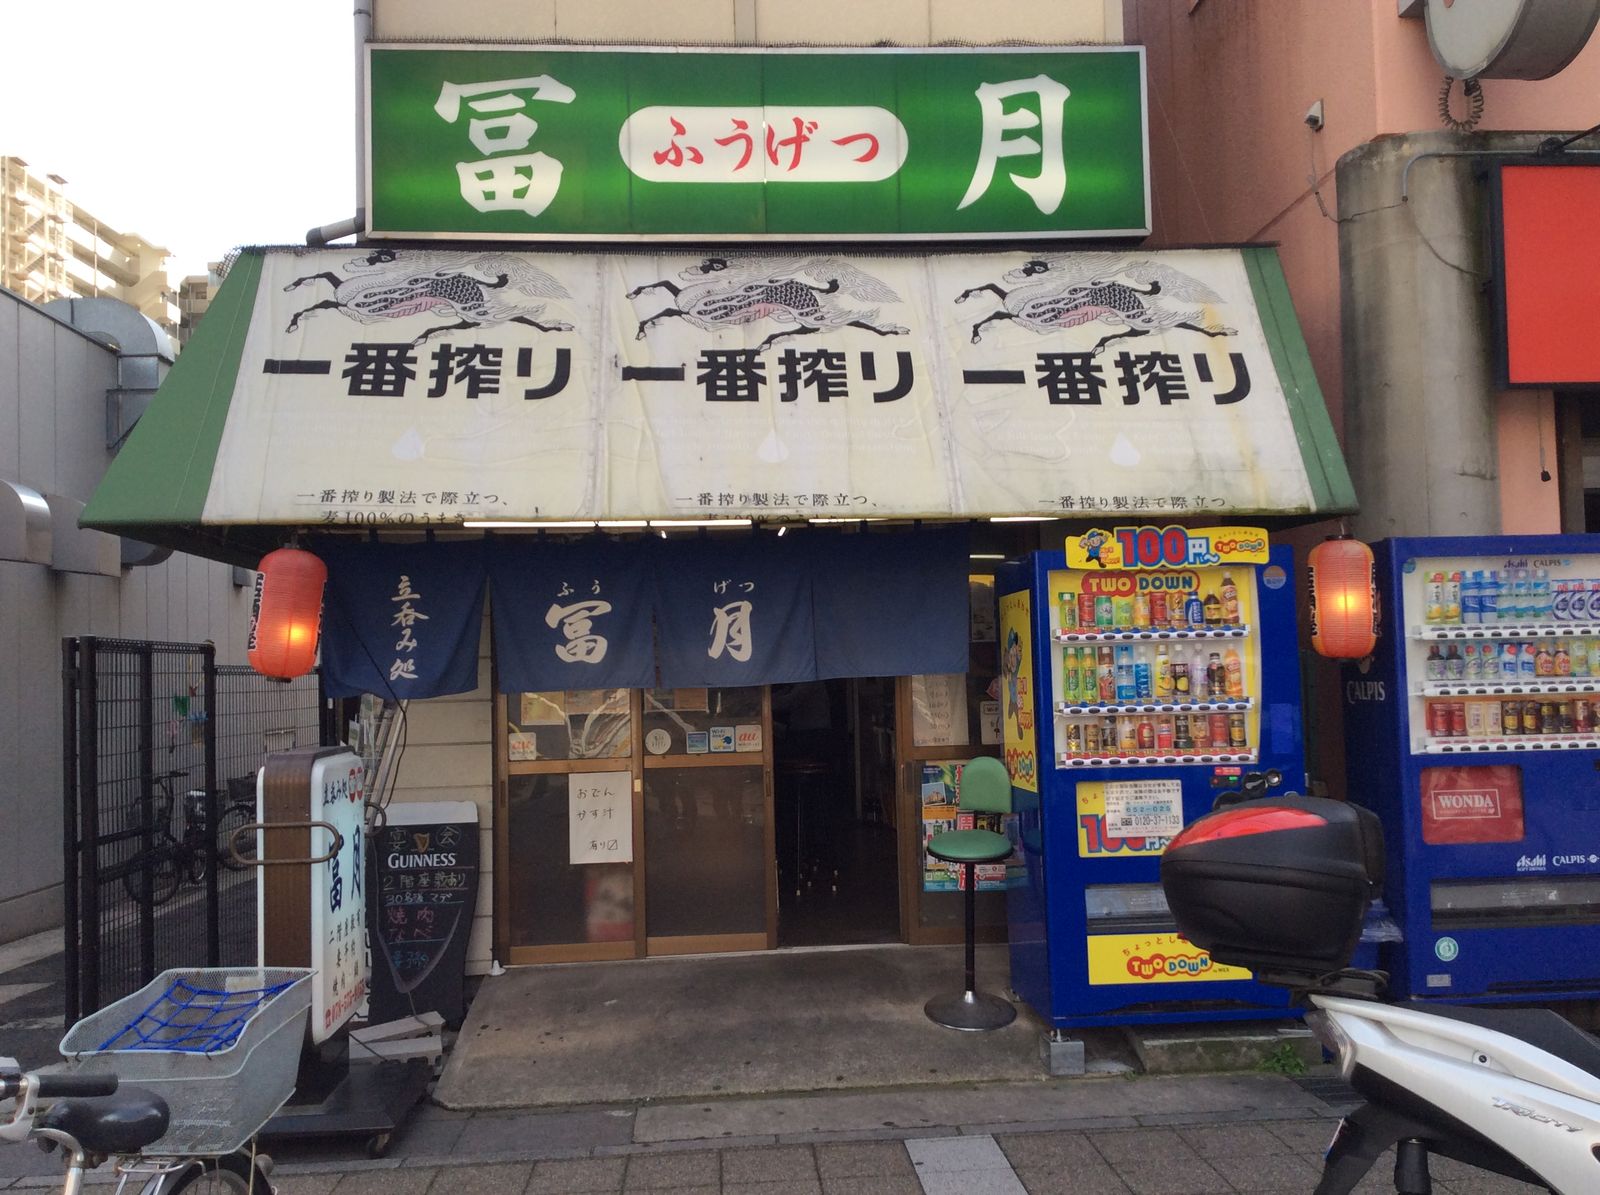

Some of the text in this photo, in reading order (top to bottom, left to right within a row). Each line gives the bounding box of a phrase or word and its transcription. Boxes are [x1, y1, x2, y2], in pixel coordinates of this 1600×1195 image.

[652, 116, 880, 173] ふうげつ
[957, 74, 1071, 215] 月
[262, 342, 571, 401] 一番搾り
[621, 348, 915, 404] 一番搾り
[963, 351, 1252, 406] 一番搾り
[1533, 559, 1562, 568] CALPIS
[556, 579, 755, 598] ふう げつ
[1088, 575, 1194, 593] TWO DOWN
[389, 575, 429, 681] 立呑み処
[707, 600, 753, 663] 月
[576, 787, 616, 800] おでん
[1438, 794, 1494, 809] WONDA
[387, 852, 456, 869] GUINNESS
[1516, 854, 1586, 867] Asahi CALPIS
[1131, 957, 1209, 976] TWO DOWN
